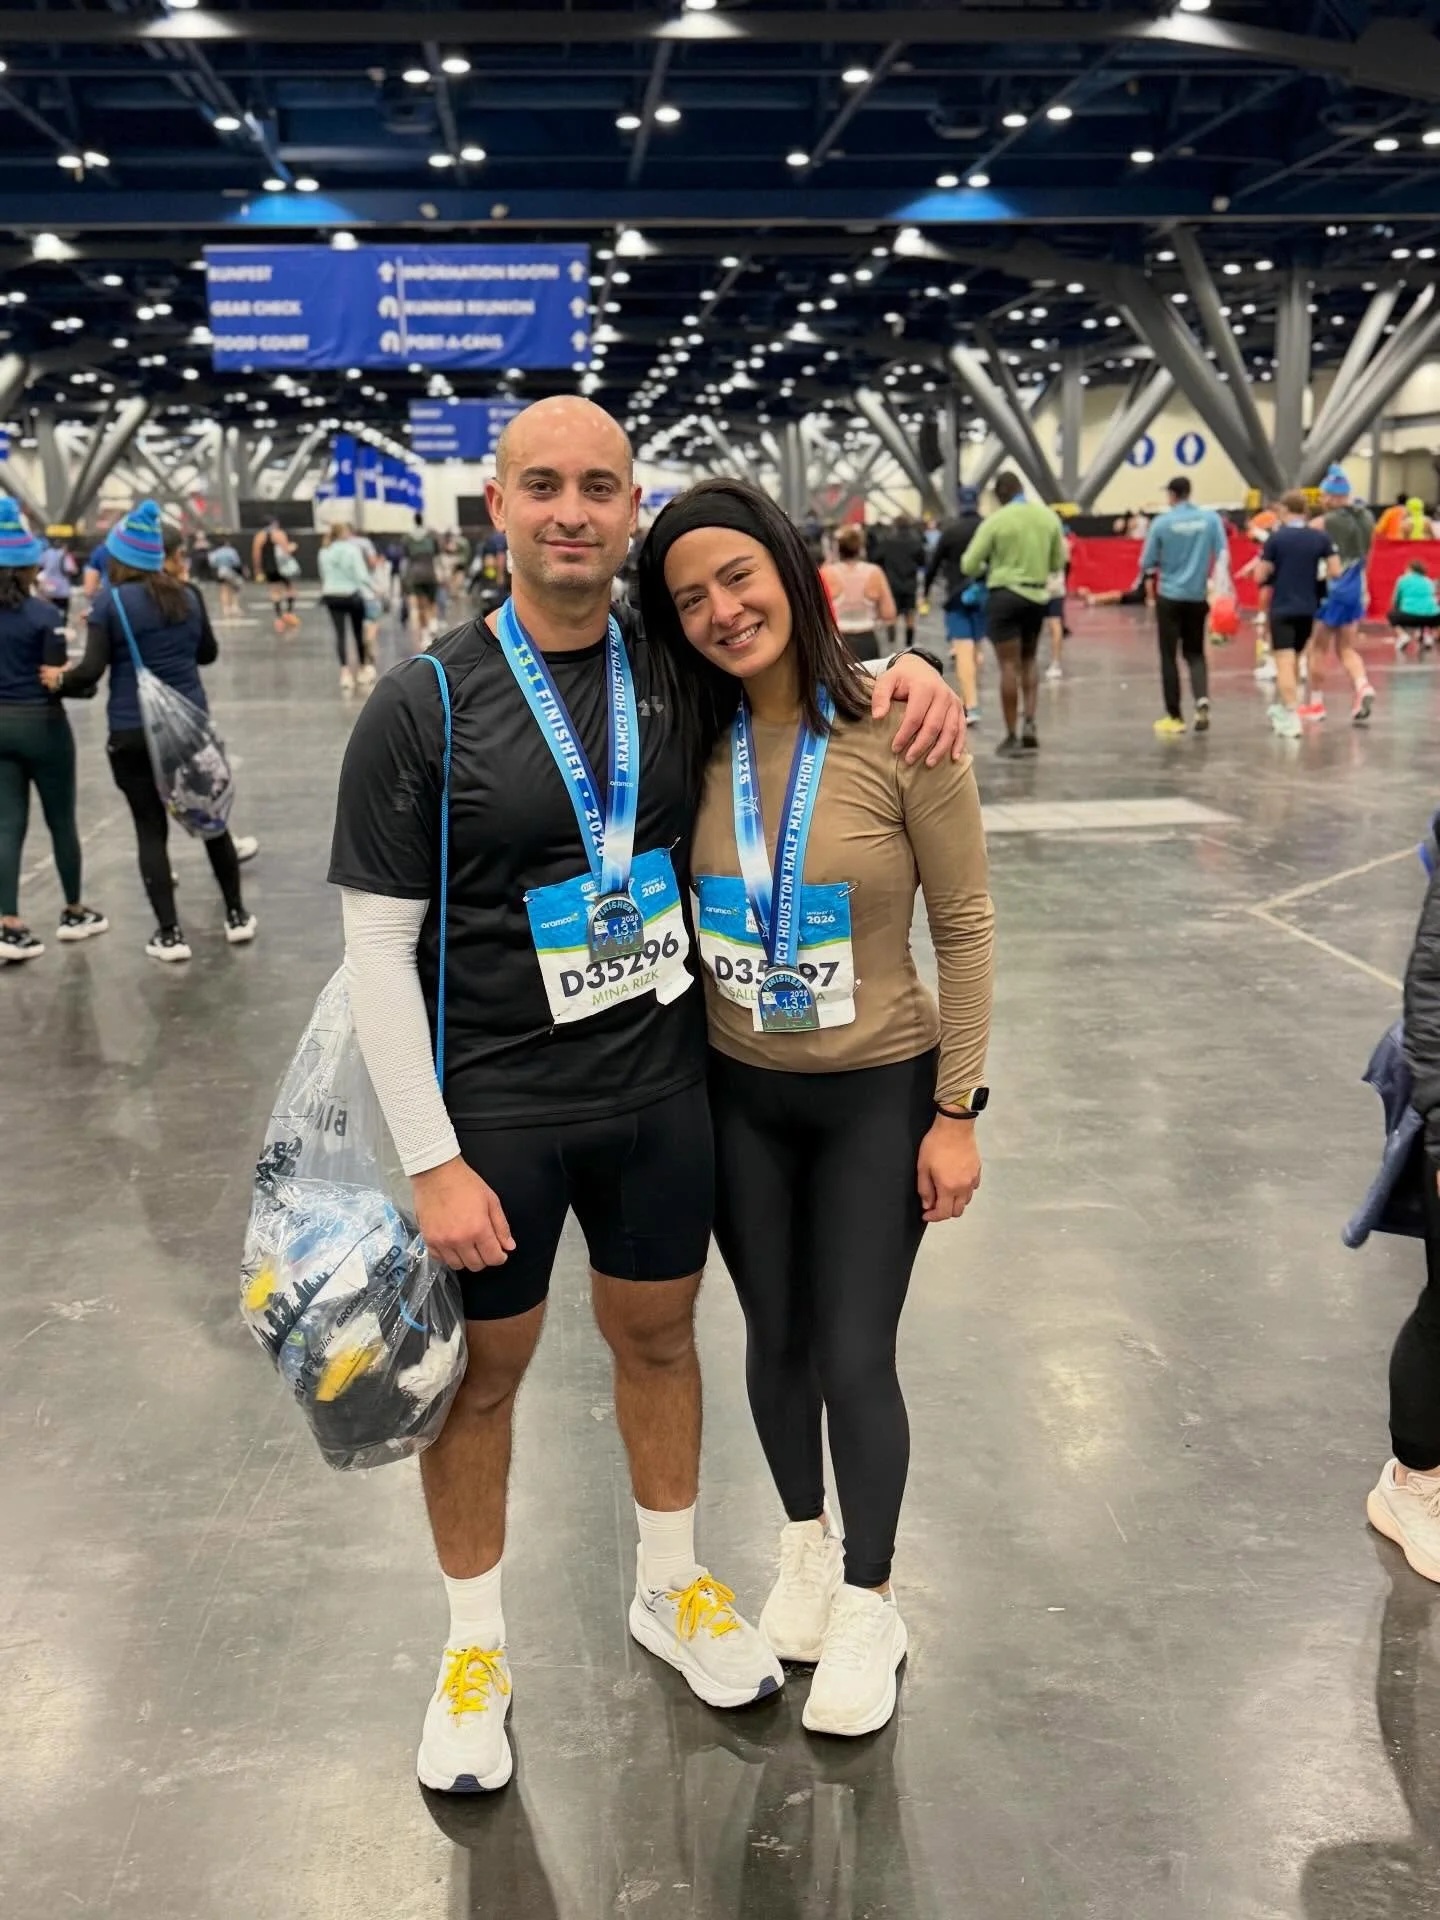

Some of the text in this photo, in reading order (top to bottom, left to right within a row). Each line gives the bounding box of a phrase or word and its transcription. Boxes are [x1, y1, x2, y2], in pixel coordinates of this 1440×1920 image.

[507, 264, 559, 280] BOOTH
[254, 300, 302, 317] CHECK
[259, 334, 309, 351] COURT
[611, 652, 626, 711] HOUSTON
[536, 688, 586, 781] FINISHER
[616, 716, 630, 772] ARAMCO
[737, 738, 751, 785] 2026
[789, 754, 816, 831] MARATHON
[784, 833, 799, 869] HALF
[641, 881, 667, 898] 2026
[540, 917, 572, 929] aramco
[704, 906, 732, 915] aramco
[778, 876, 795, 938] HOUSTON
[806, 914, 836, 925] 2026
[613, 920, 640, 938] 13.1
[559, 931, 680, 998] D35296
[714, 955, 840, 988] D3597
[591, 968, 661, 1006] MINA RIZK
[782, 997, 810, 1010] 13.1
[790, 990, 809, 998] 2026
[335, 1286, 369, 1329] BROOKS
